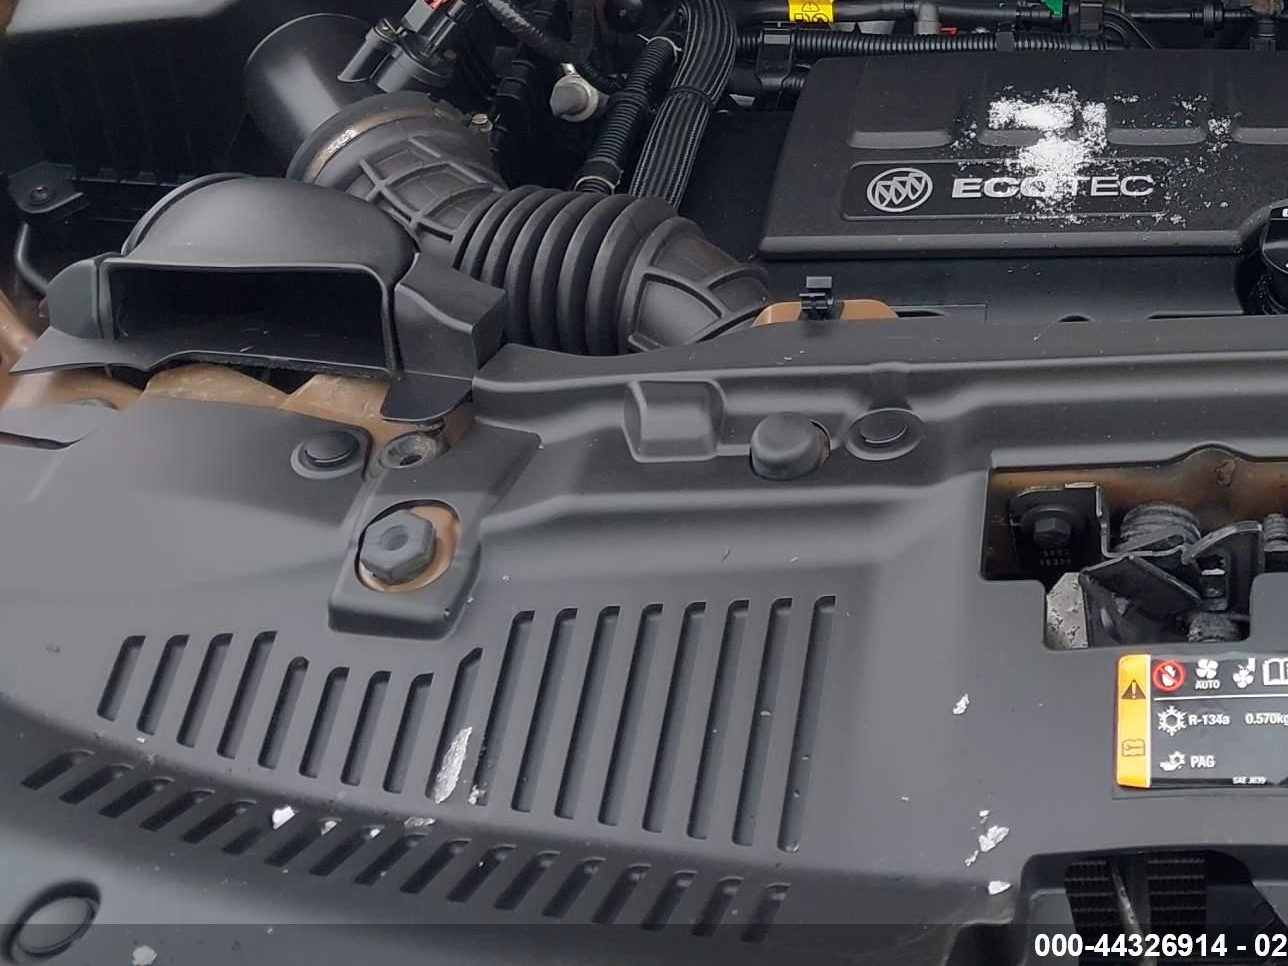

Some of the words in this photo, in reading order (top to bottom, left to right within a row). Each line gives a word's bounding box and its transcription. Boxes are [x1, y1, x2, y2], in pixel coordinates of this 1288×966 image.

[1195, 679, 1220, 690] AUTO
[1188, 714, 1230, 725] R-134a
[1190, 755, 1216, 768] PAG
